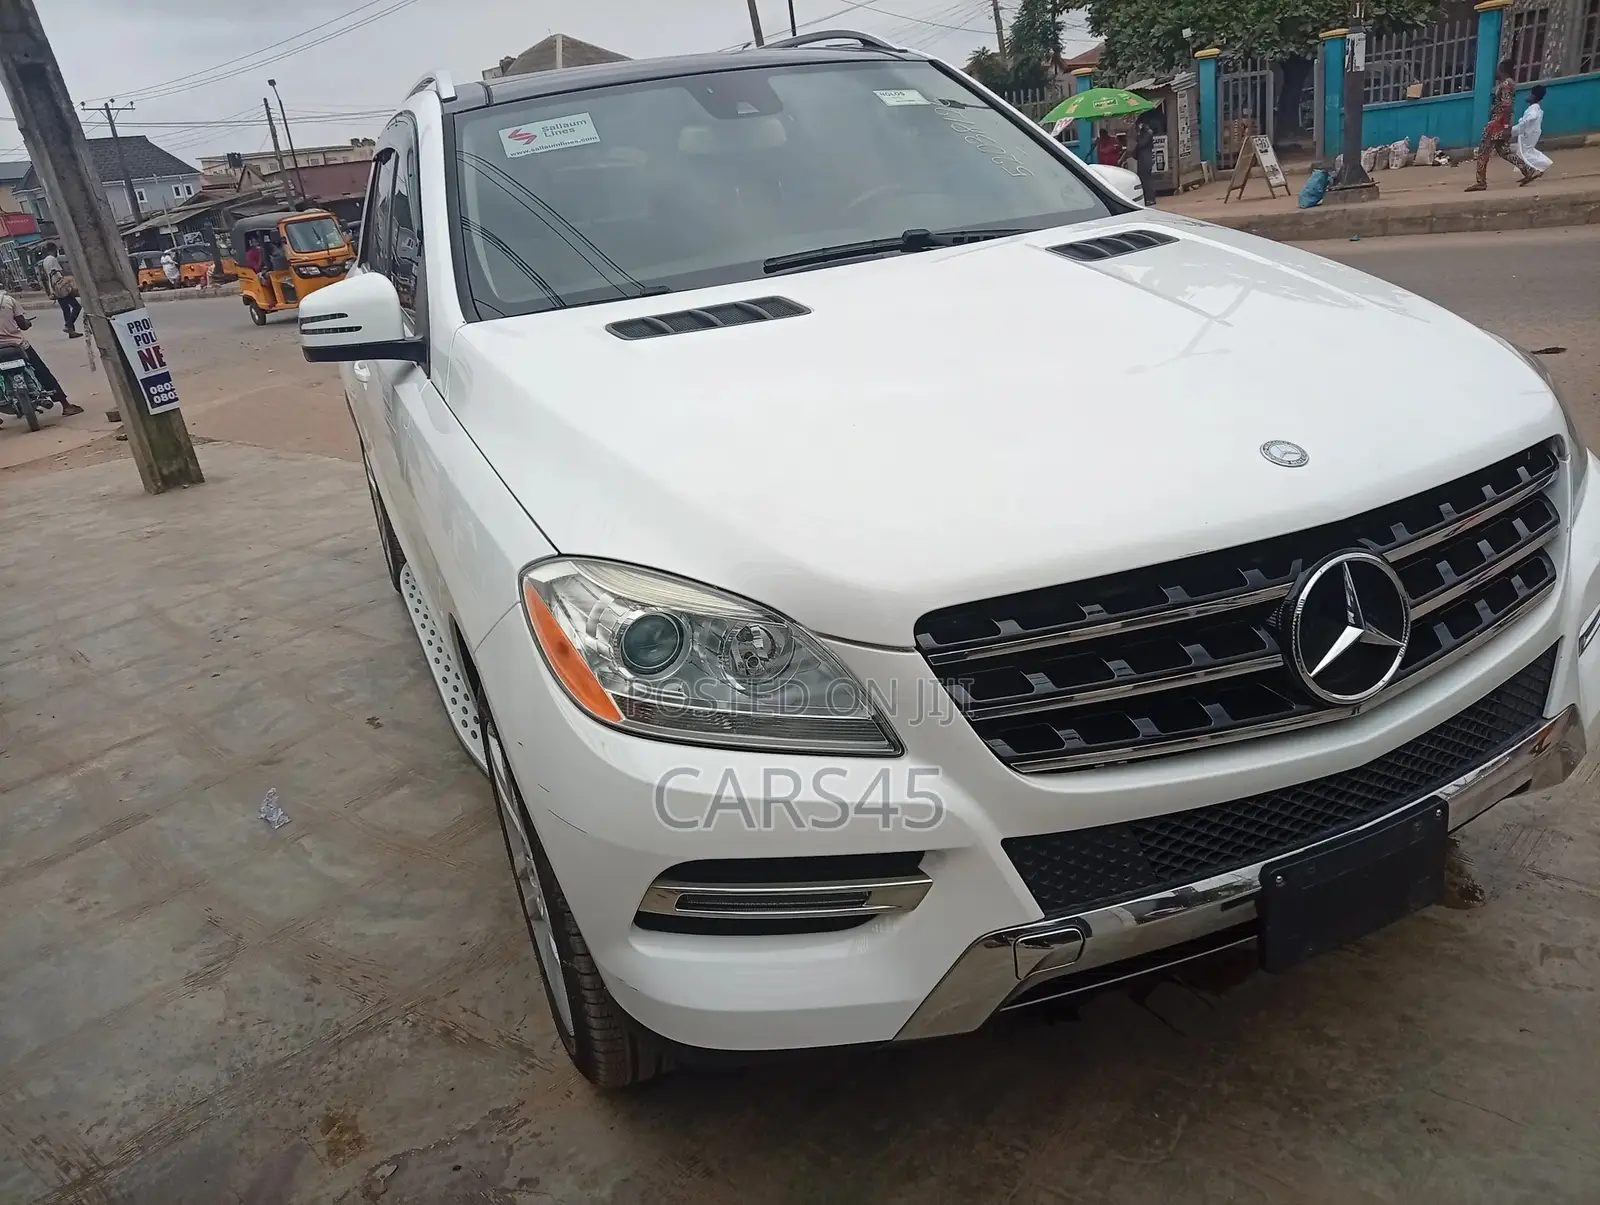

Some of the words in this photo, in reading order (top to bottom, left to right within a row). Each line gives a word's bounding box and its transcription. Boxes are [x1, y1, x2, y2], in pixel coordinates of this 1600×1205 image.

[541, 119, 587, 133] Sallaum
[544, 127, 576, 138] Lines
[510, 136, 598, 157] www.sallaumlines.com
[126, 317, 153, 334] PRO
[133, 331, 157, 347] POL
